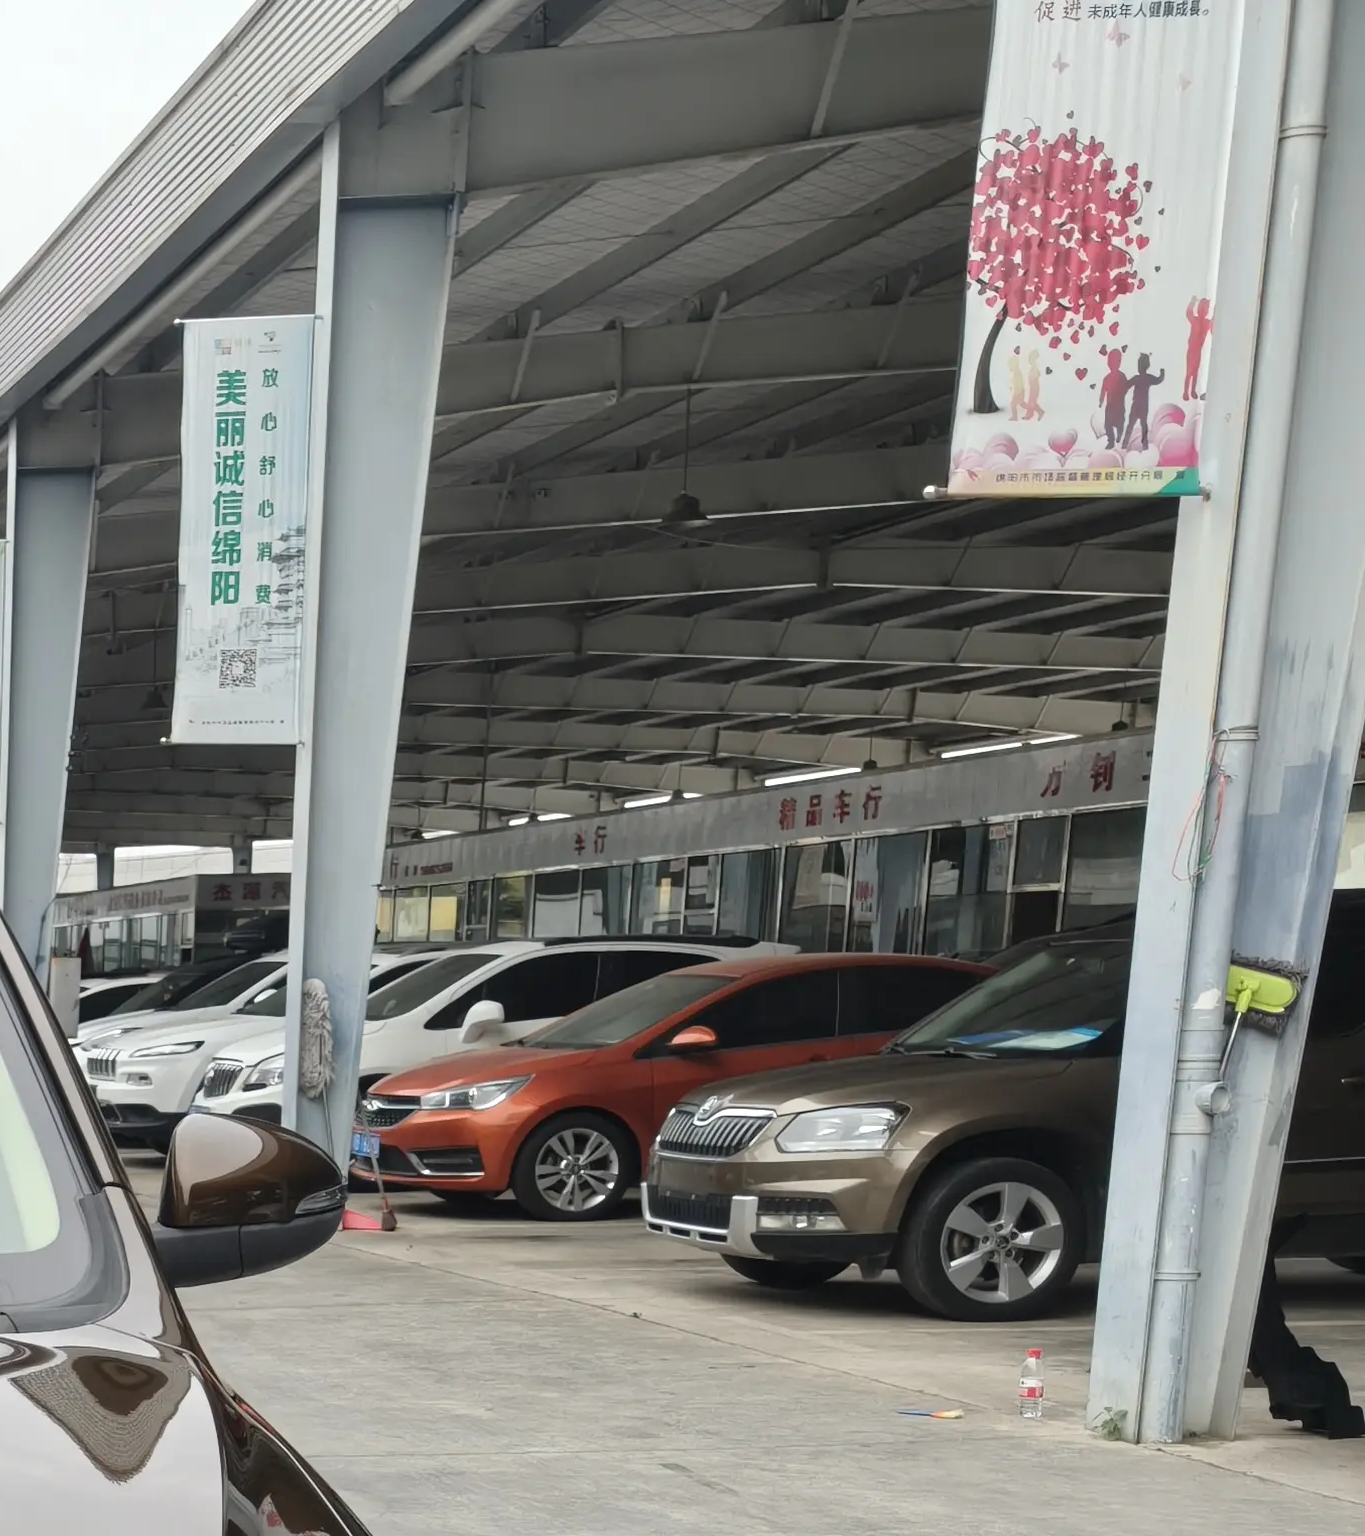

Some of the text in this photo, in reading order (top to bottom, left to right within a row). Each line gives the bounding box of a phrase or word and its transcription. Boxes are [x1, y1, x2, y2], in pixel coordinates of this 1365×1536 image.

[210, 370, 246, 606] 美丽诚信绵阳
[255, 368, 279, 606] 放心舒心消费
[779, 785, 883, 831] 精品车行
